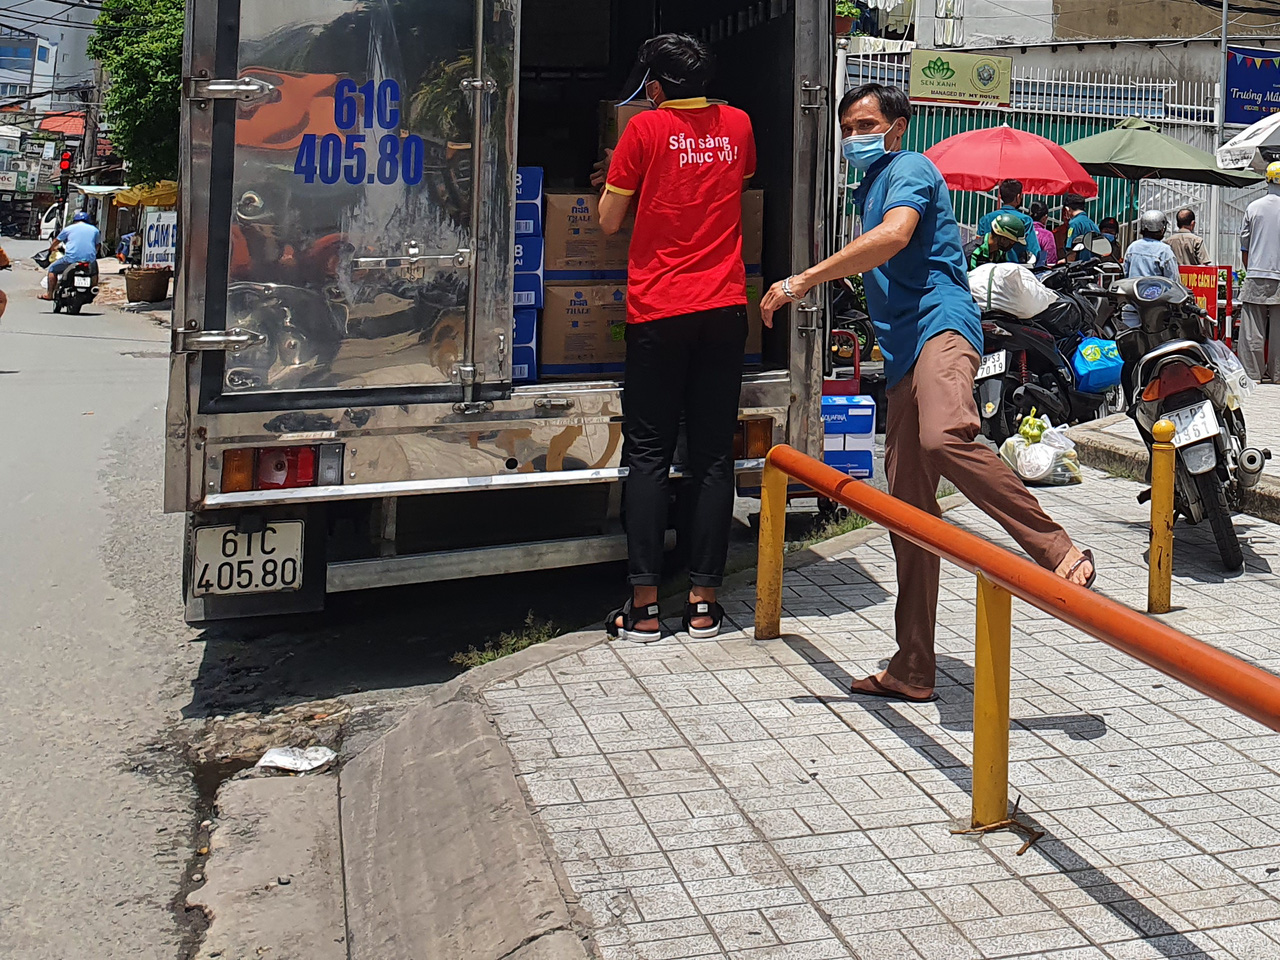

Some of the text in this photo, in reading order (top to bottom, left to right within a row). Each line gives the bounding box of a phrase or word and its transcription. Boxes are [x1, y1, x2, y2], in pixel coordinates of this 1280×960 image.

[334, 78, 400, 130] 61C
[669, 132, 731, 151] Sẵn sàng
[293, 132, 424, 185] 405.80
[679, 148, 714, 168] phục
[981, 353, 1001, 366] 9-S3
[821, 413, 847, 422] AQUAFINA
[197, 557, 297, 592] 405.80
